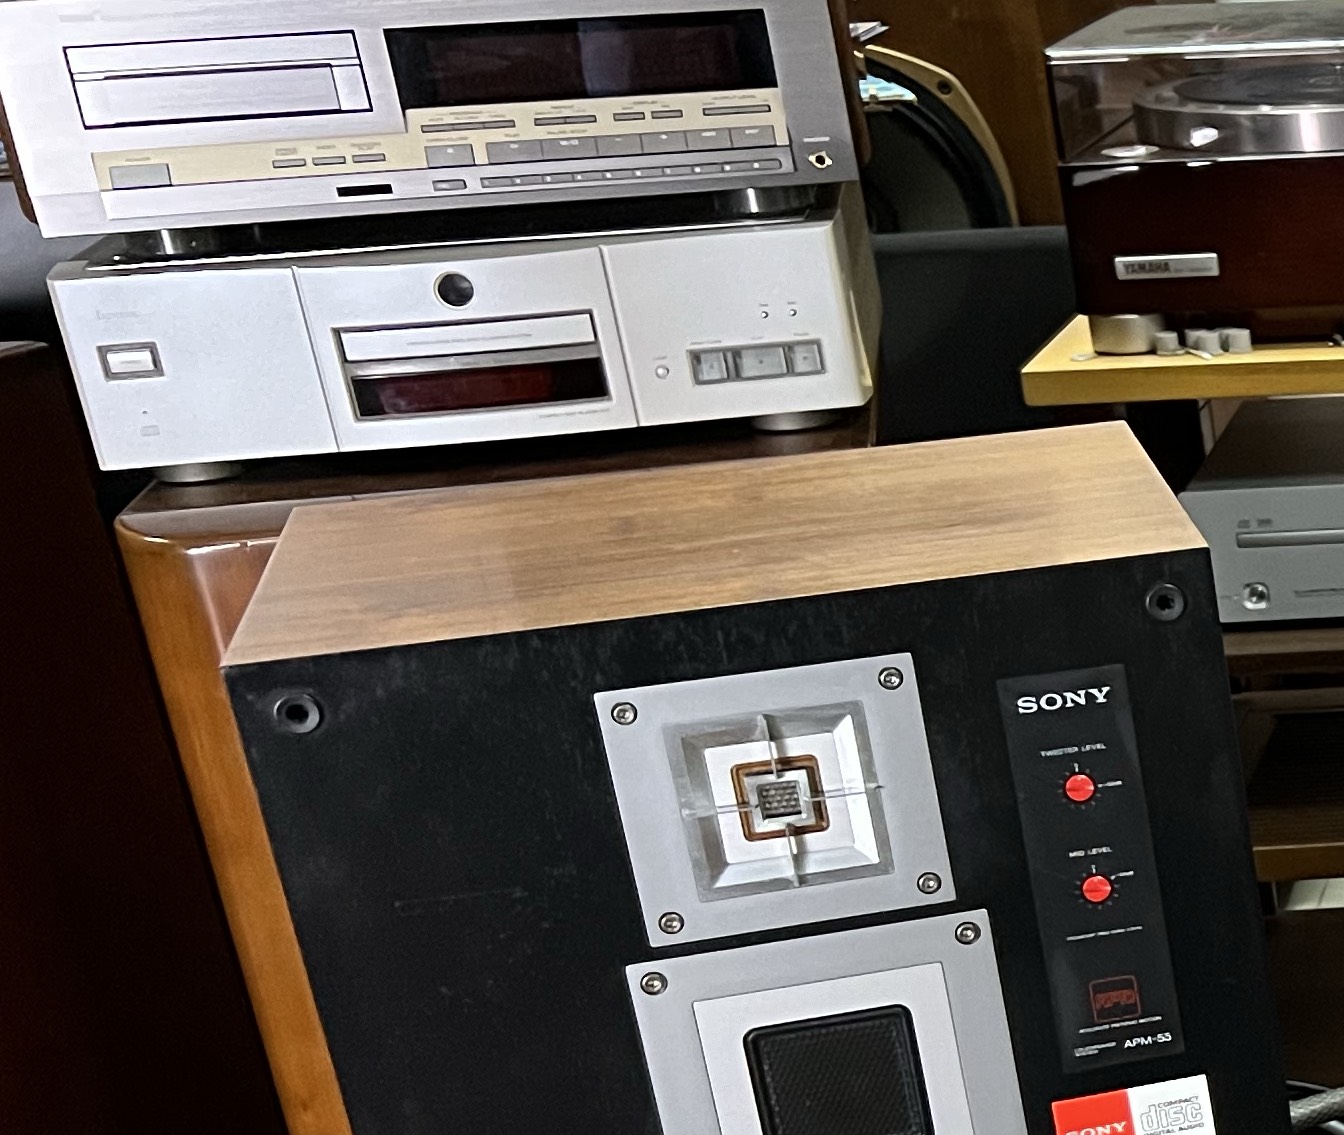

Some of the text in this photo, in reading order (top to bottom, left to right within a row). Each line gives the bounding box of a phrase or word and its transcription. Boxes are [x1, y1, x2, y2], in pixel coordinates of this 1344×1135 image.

[1123, 262, 1171, 275] YAMAHA
[1016, 685, 1111, 714] SONY
[1140, 1103, 1203, 1132] disc
